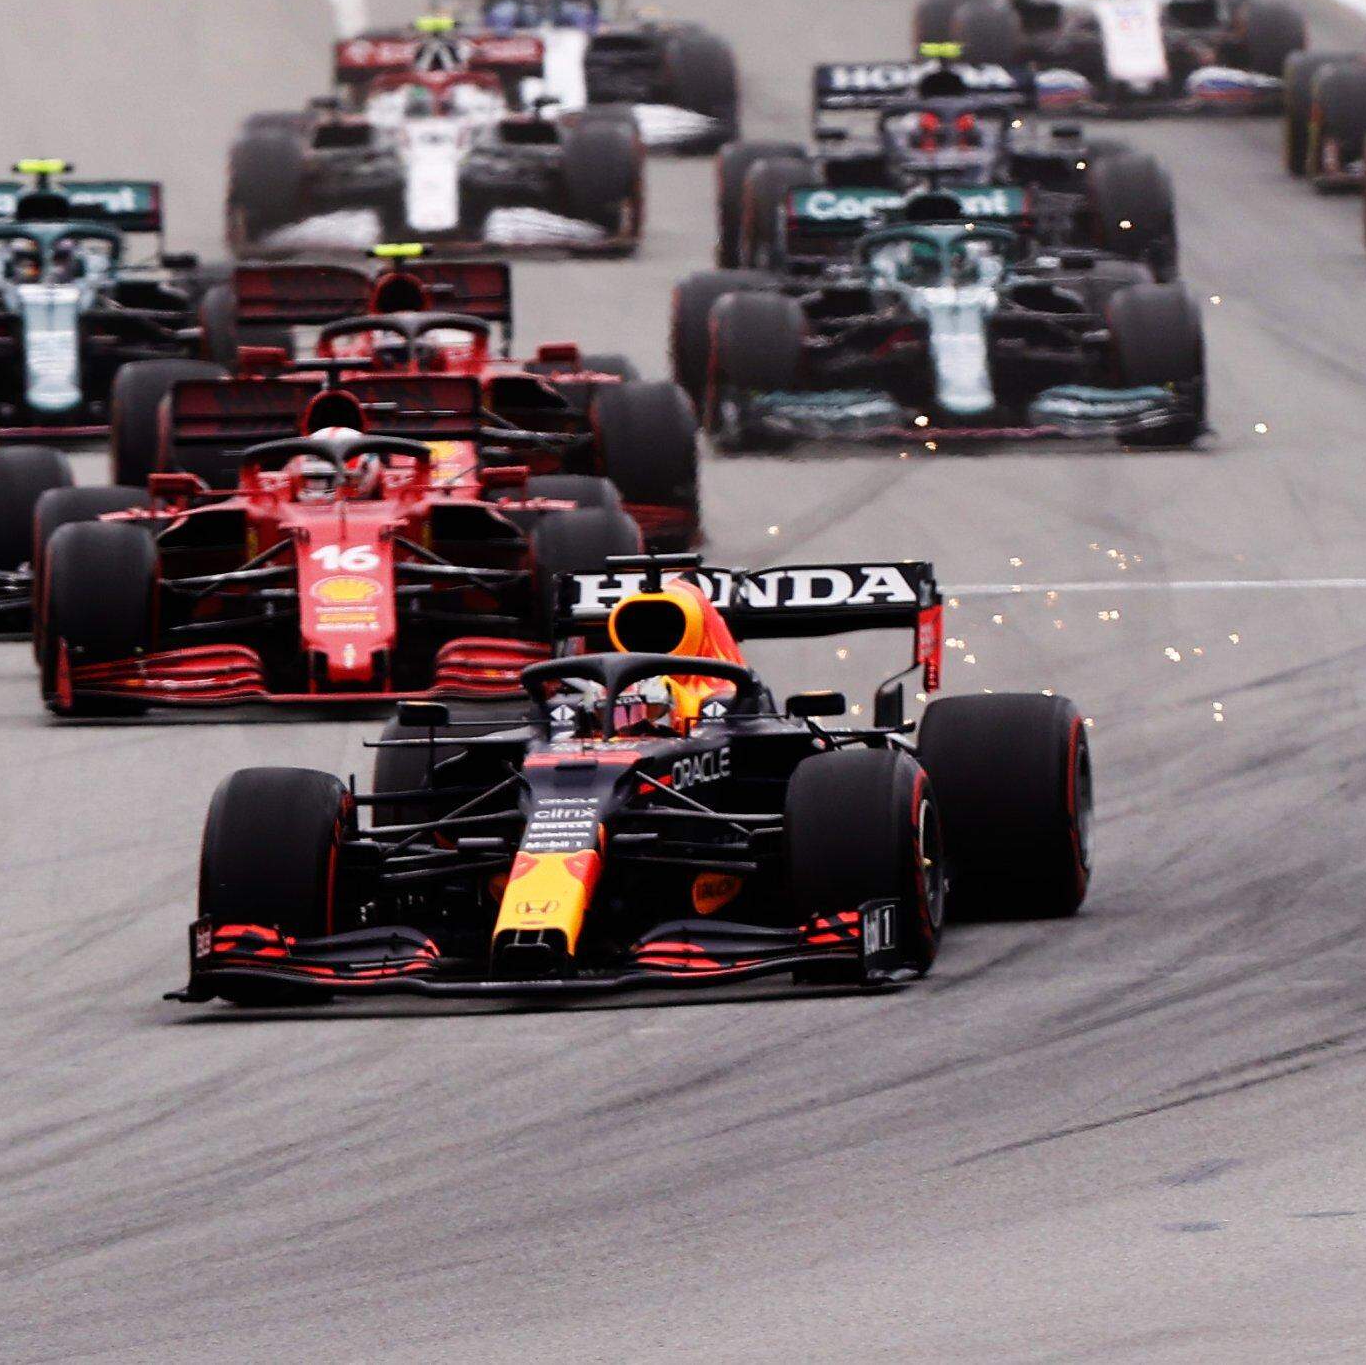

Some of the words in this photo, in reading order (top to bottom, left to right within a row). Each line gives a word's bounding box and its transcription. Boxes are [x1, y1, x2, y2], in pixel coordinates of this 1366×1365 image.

[310, 544, 381, 571] 16
[672, 746, 731, 790] ORACLE
[534, 808, 597, 819] citrix
